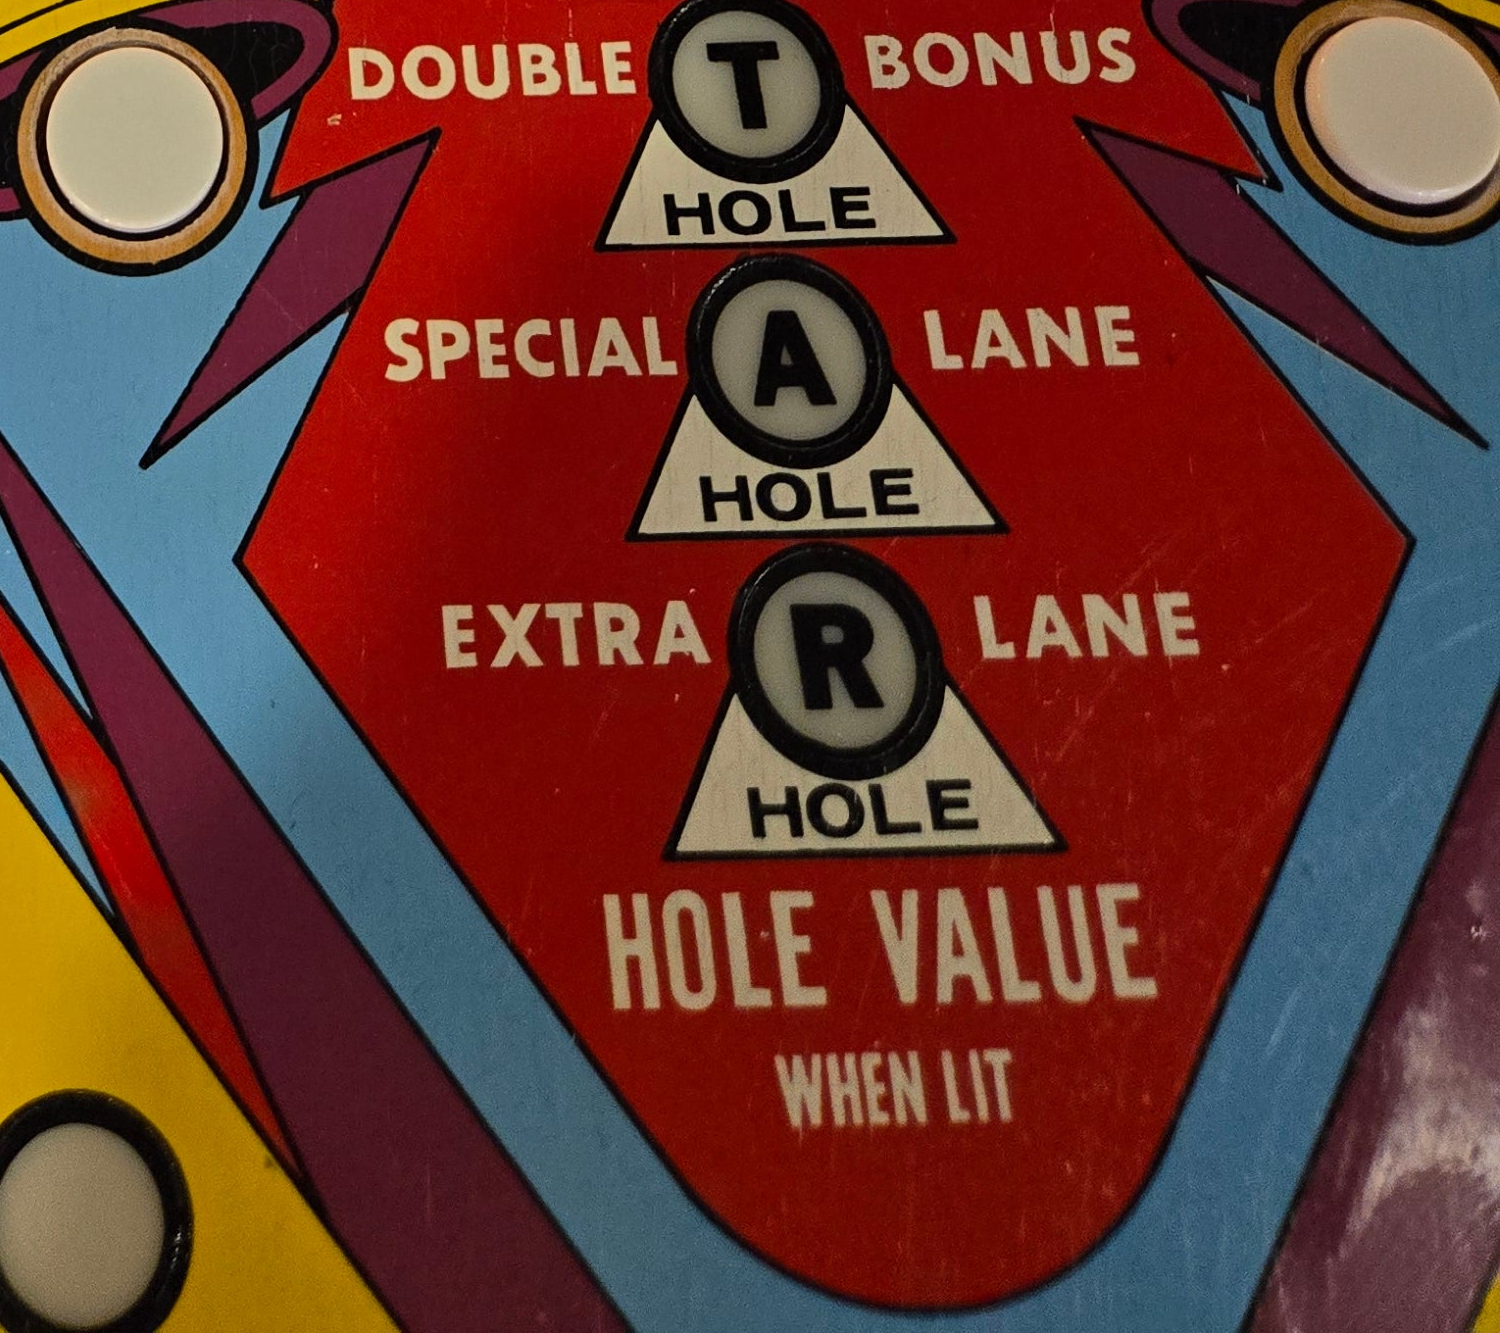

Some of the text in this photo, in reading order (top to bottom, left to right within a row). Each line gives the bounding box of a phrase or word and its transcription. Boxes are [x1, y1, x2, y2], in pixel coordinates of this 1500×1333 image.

[347, 28, 1137, 101] DOUBLE BONUS
[706, 41, 781, 130] T
[663, 186, 878, 237] HOLE
[384, 305, 1140, 382] SPECIAL LANE
[753, 309, 837, 407] A
[698, 468, 920, 523] HOLE
[441, 591, 1201, 669] EXTRA LANE
[789, 603, 885, 711] R
[747, 778, 980, 840] HOLE
[603, 882, 1158, 1012] HOLE VALUE
[774, 1047, 1014, 1130] WHEN LIT
